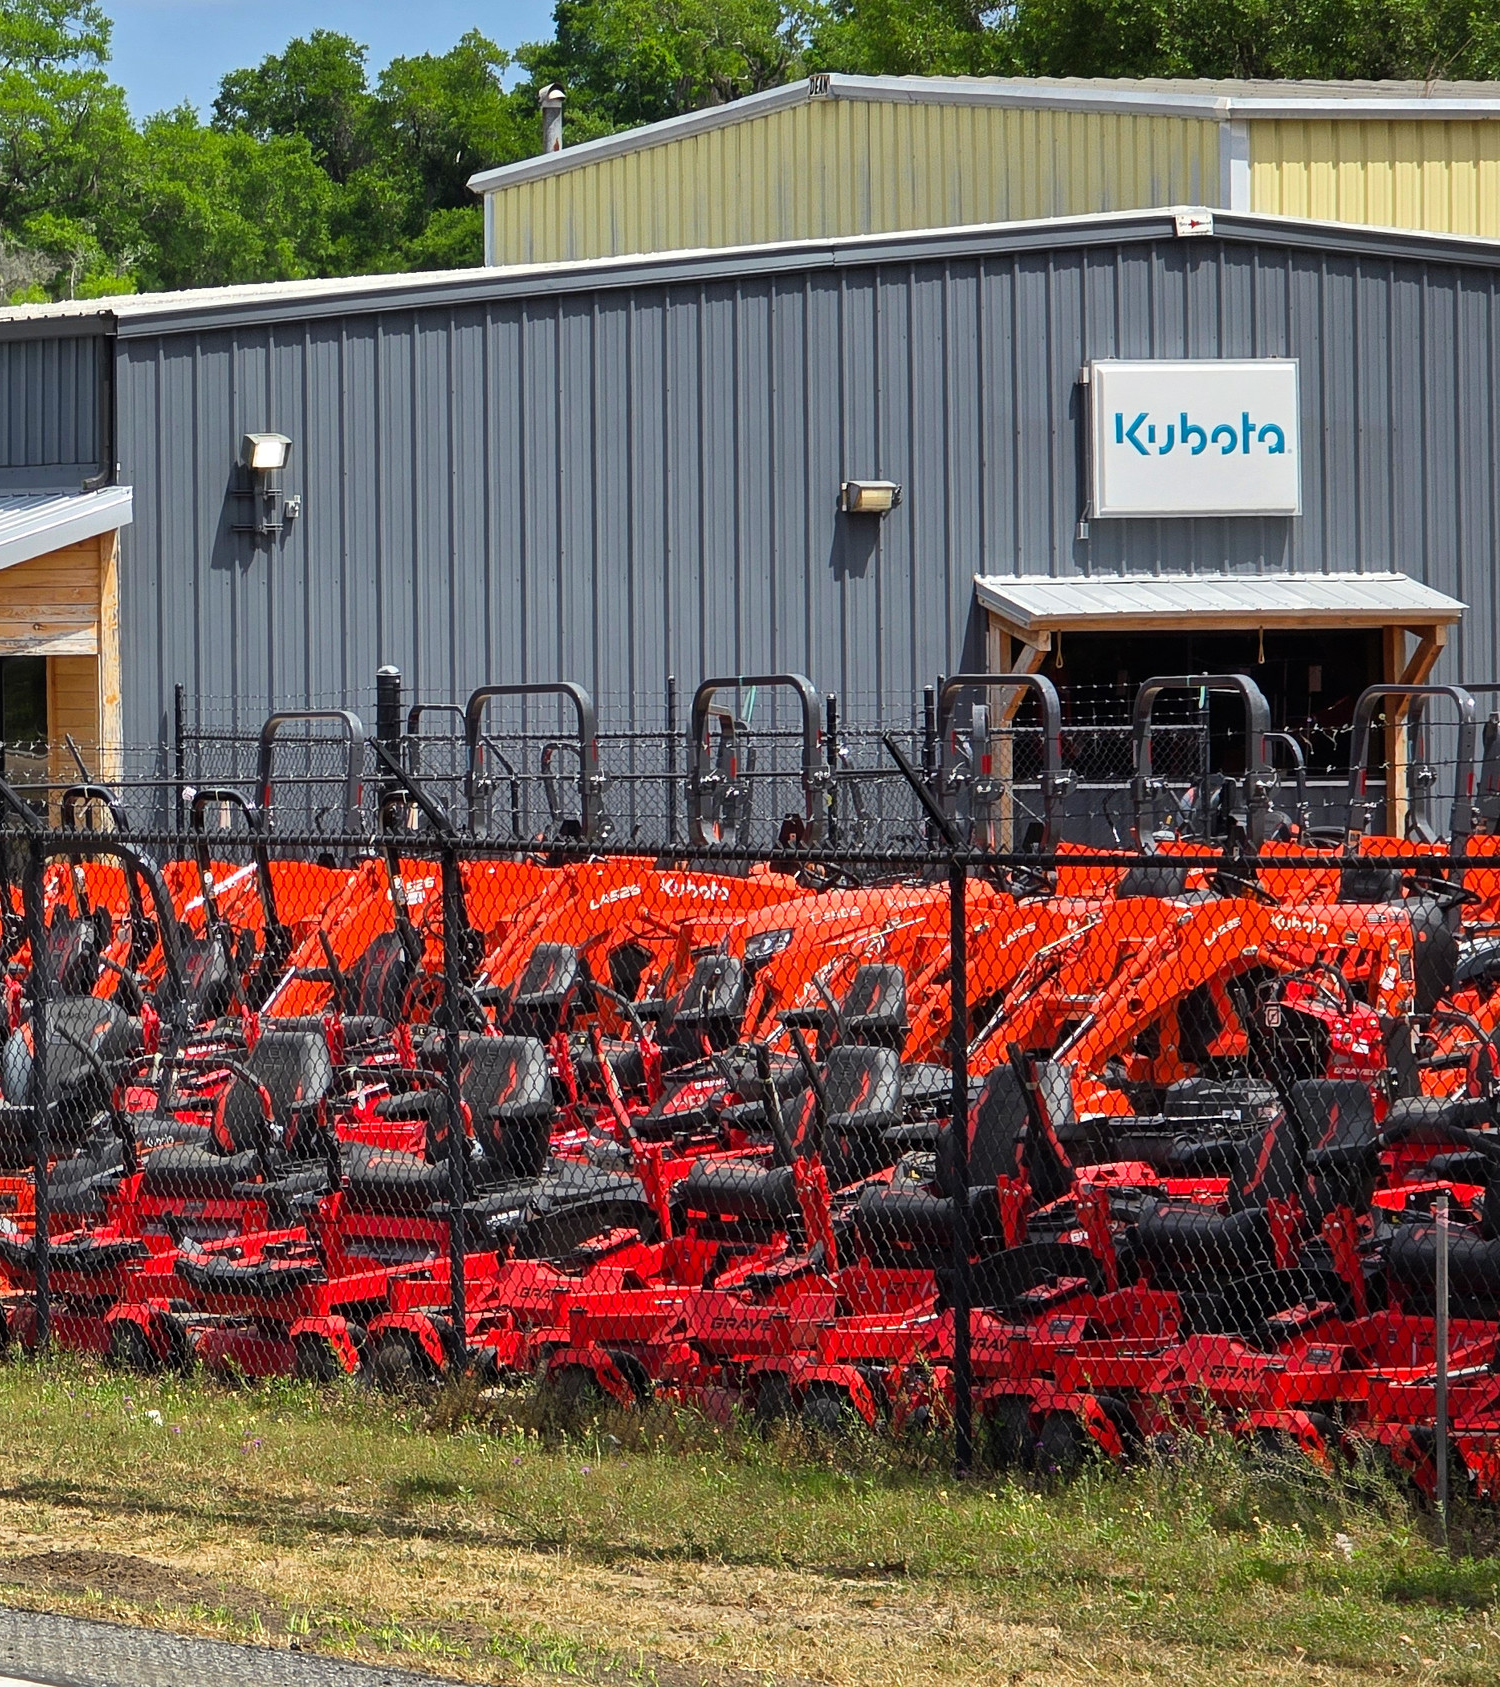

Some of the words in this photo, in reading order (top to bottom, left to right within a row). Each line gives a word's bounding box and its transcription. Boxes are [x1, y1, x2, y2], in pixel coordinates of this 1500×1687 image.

[1115, 411, 1286, 456] Kubota
[660, 877, 730, 901] Kubota
[1271, 913, 1328, 936] Kubota
[711, 1317, 771, 1331] GRAVE
